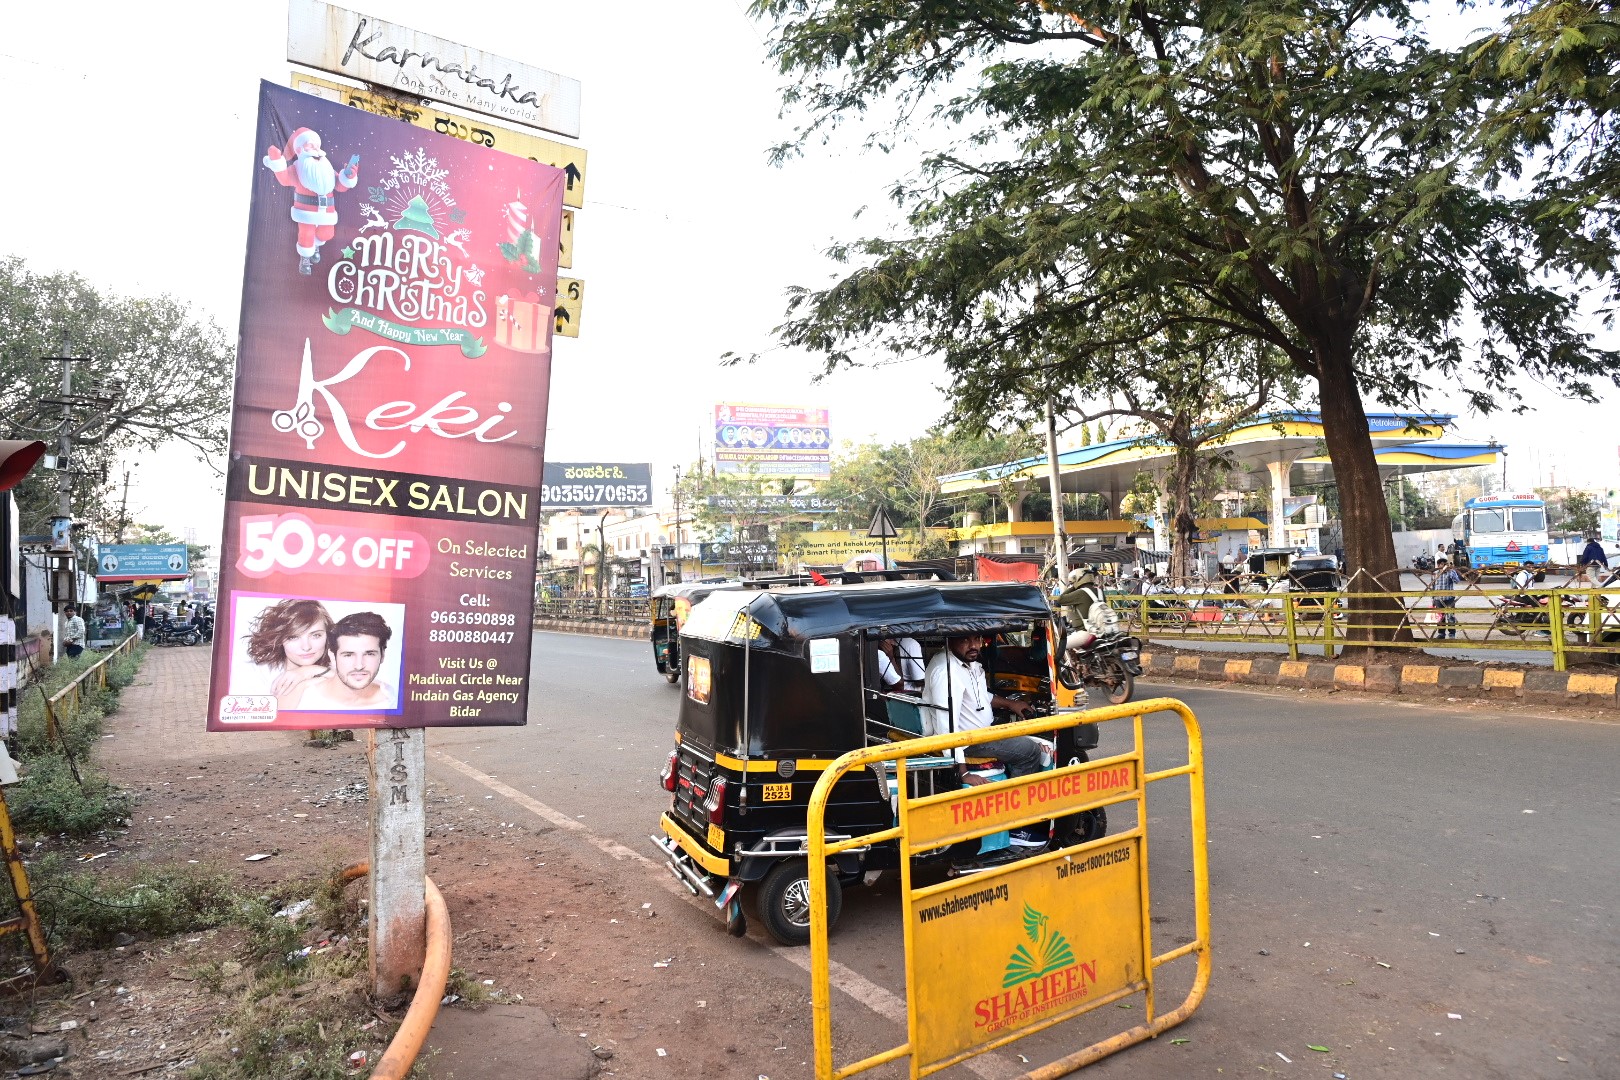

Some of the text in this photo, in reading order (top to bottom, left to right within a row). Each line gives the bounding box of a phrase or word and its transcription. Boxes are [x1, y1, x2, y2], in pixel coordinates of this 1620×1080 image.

[341, 18, 541, 108] Karnataka
[401, 76, 540, 121] One state. Many worlds.
[380, 173, 457, 207] Joy to the world!
[351, 310, 464, 342] And Happy New Year
[272, 337, 517, 458] Keki
[1371, 418, 1403, 427] Petroleum
[248, 465, 528, 519] UNISEX SALON
[541, 484, 648, 502] 9035070653
[243, 519, 413, 573] 50% OFF
[437, 537, 527, 559] On Selected
[449, 562, 512, 580] Services
[460, 594, 490, 607] Cell:
[430, 611, 516, 626] 9663690898
[429, 630, 514, 644] 8800880447
[438, 658, 498, 670] Visit Us @
[409, 673, 523, 685] Madival Circle Near
[411, 690, 519, 704] Indain Gas Agency
[449, 706, 481, 717] Bidar
[764, 790, 791, 800] 2523
[951, 768, 1129, 825] TRAFFIC POLICE BIDAR
[1056, 863, 1069, 879] Toll
[919, 883, 1009, 923] www.shaheengroup.org
[974, 960, 1096, 1028] SHAHEEN
[987, 989, 1088, 1033] GROUP OF INSTITUTIONS
